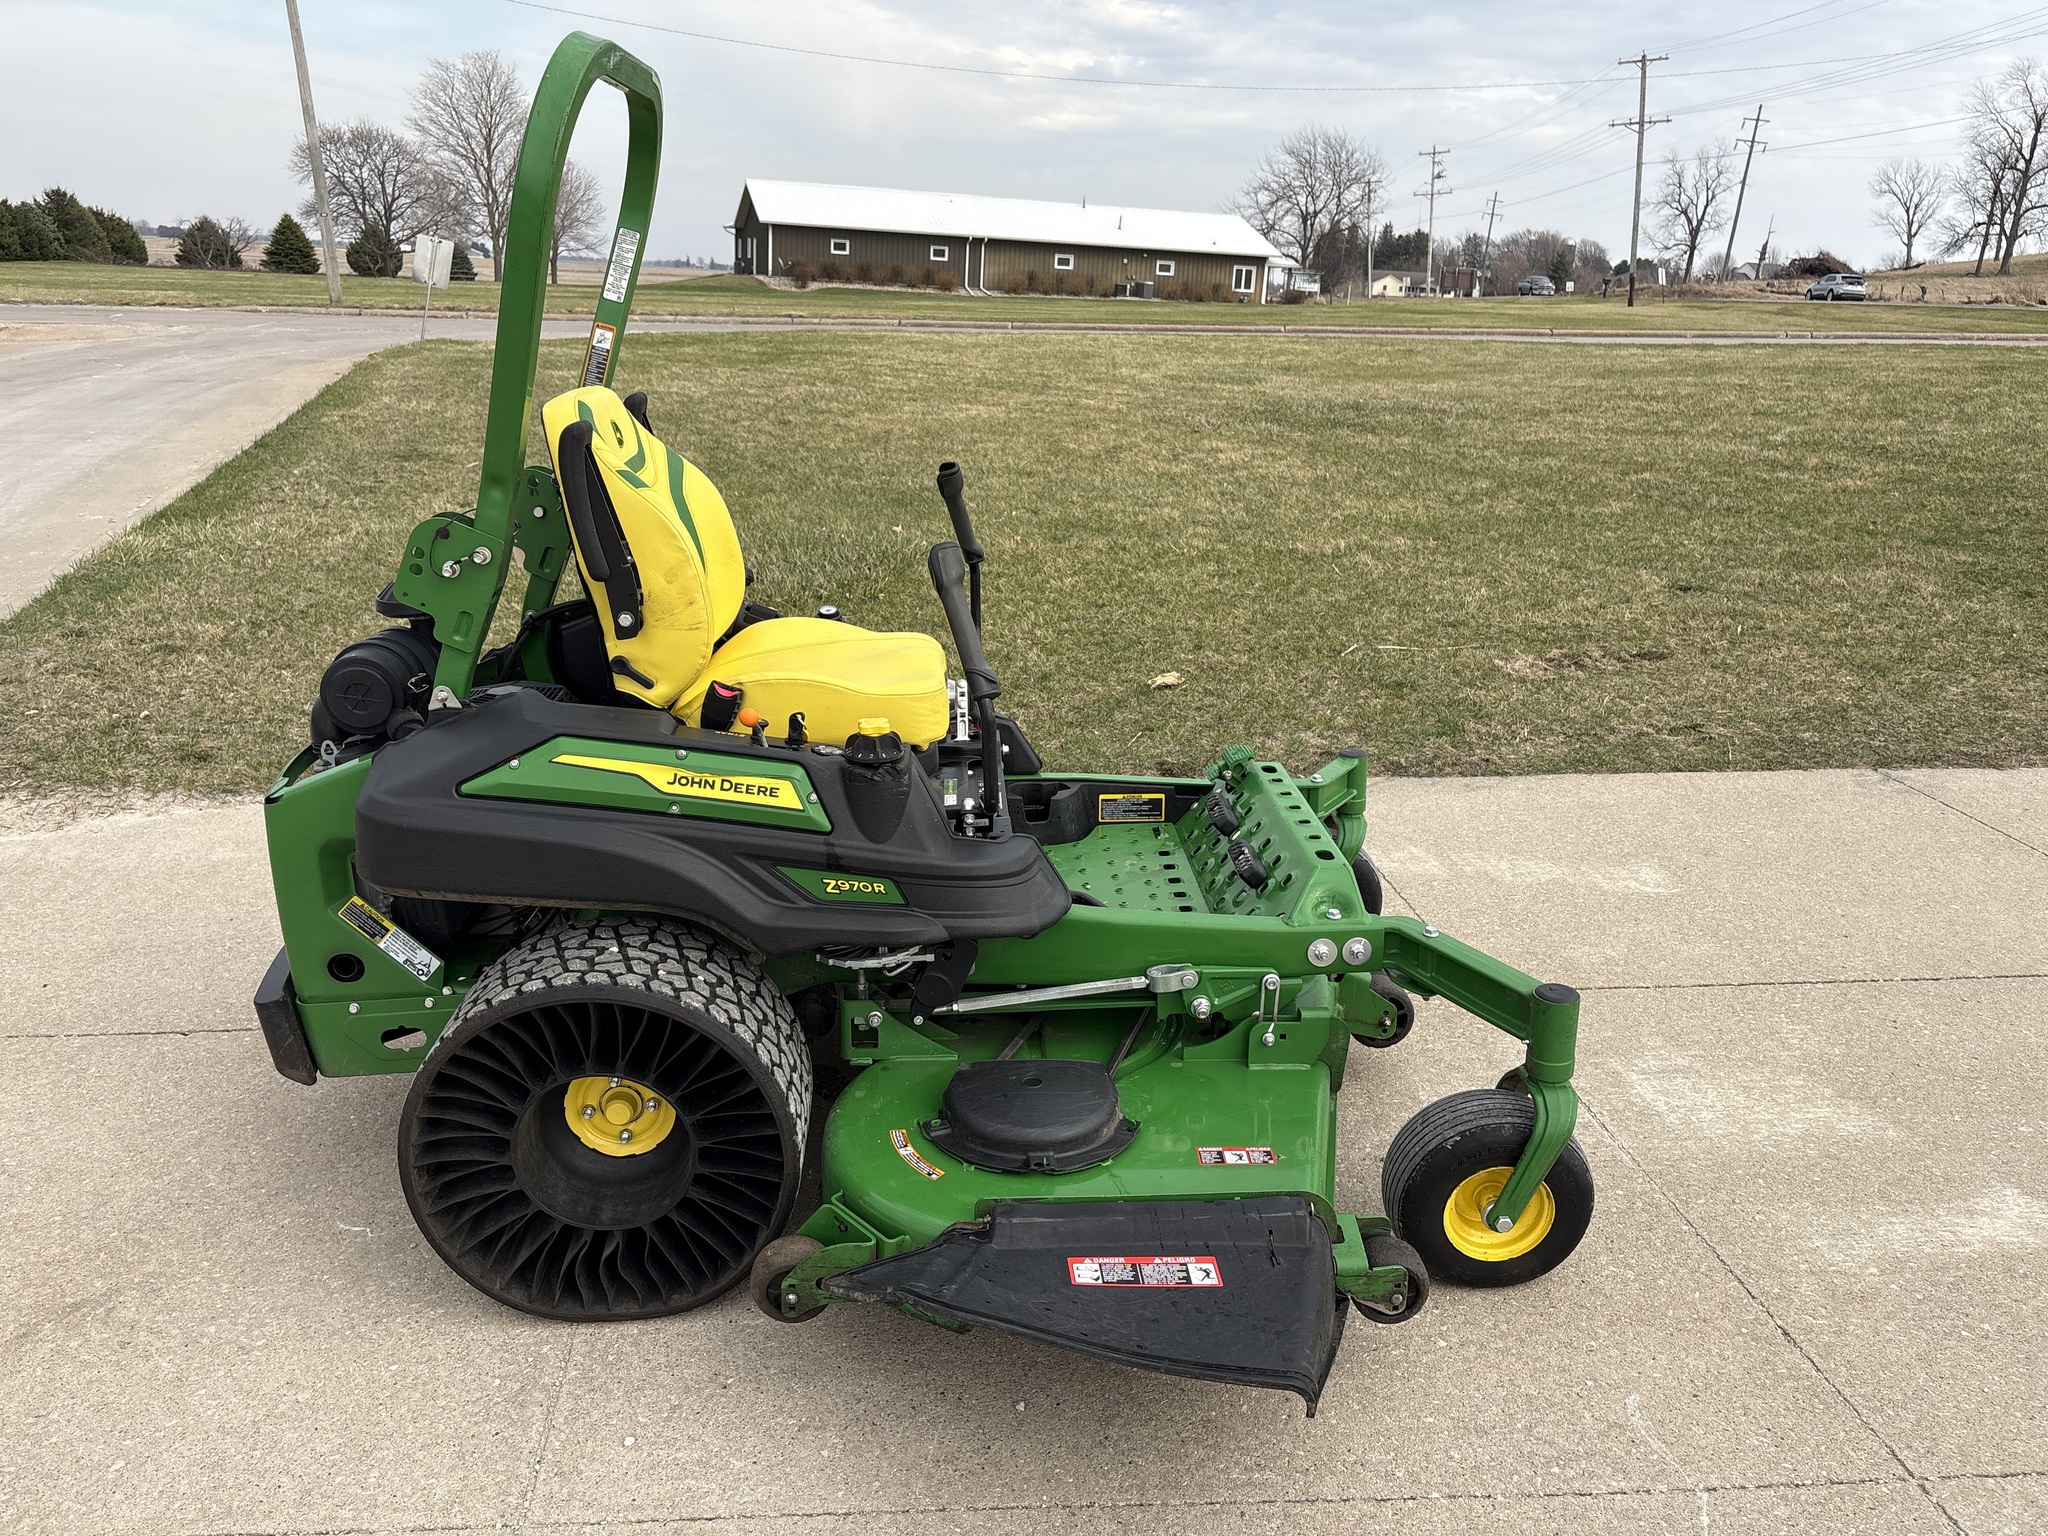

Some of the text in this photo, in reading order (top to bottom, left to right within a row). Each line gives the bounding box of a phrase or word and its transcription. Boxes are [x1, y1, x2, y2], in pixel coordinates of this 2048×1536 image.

[667, 773, 780, 798] JOHN DEERE
[821, 878, 887, 895] Z970R
[362, 906, 385, 923] CAUTION
